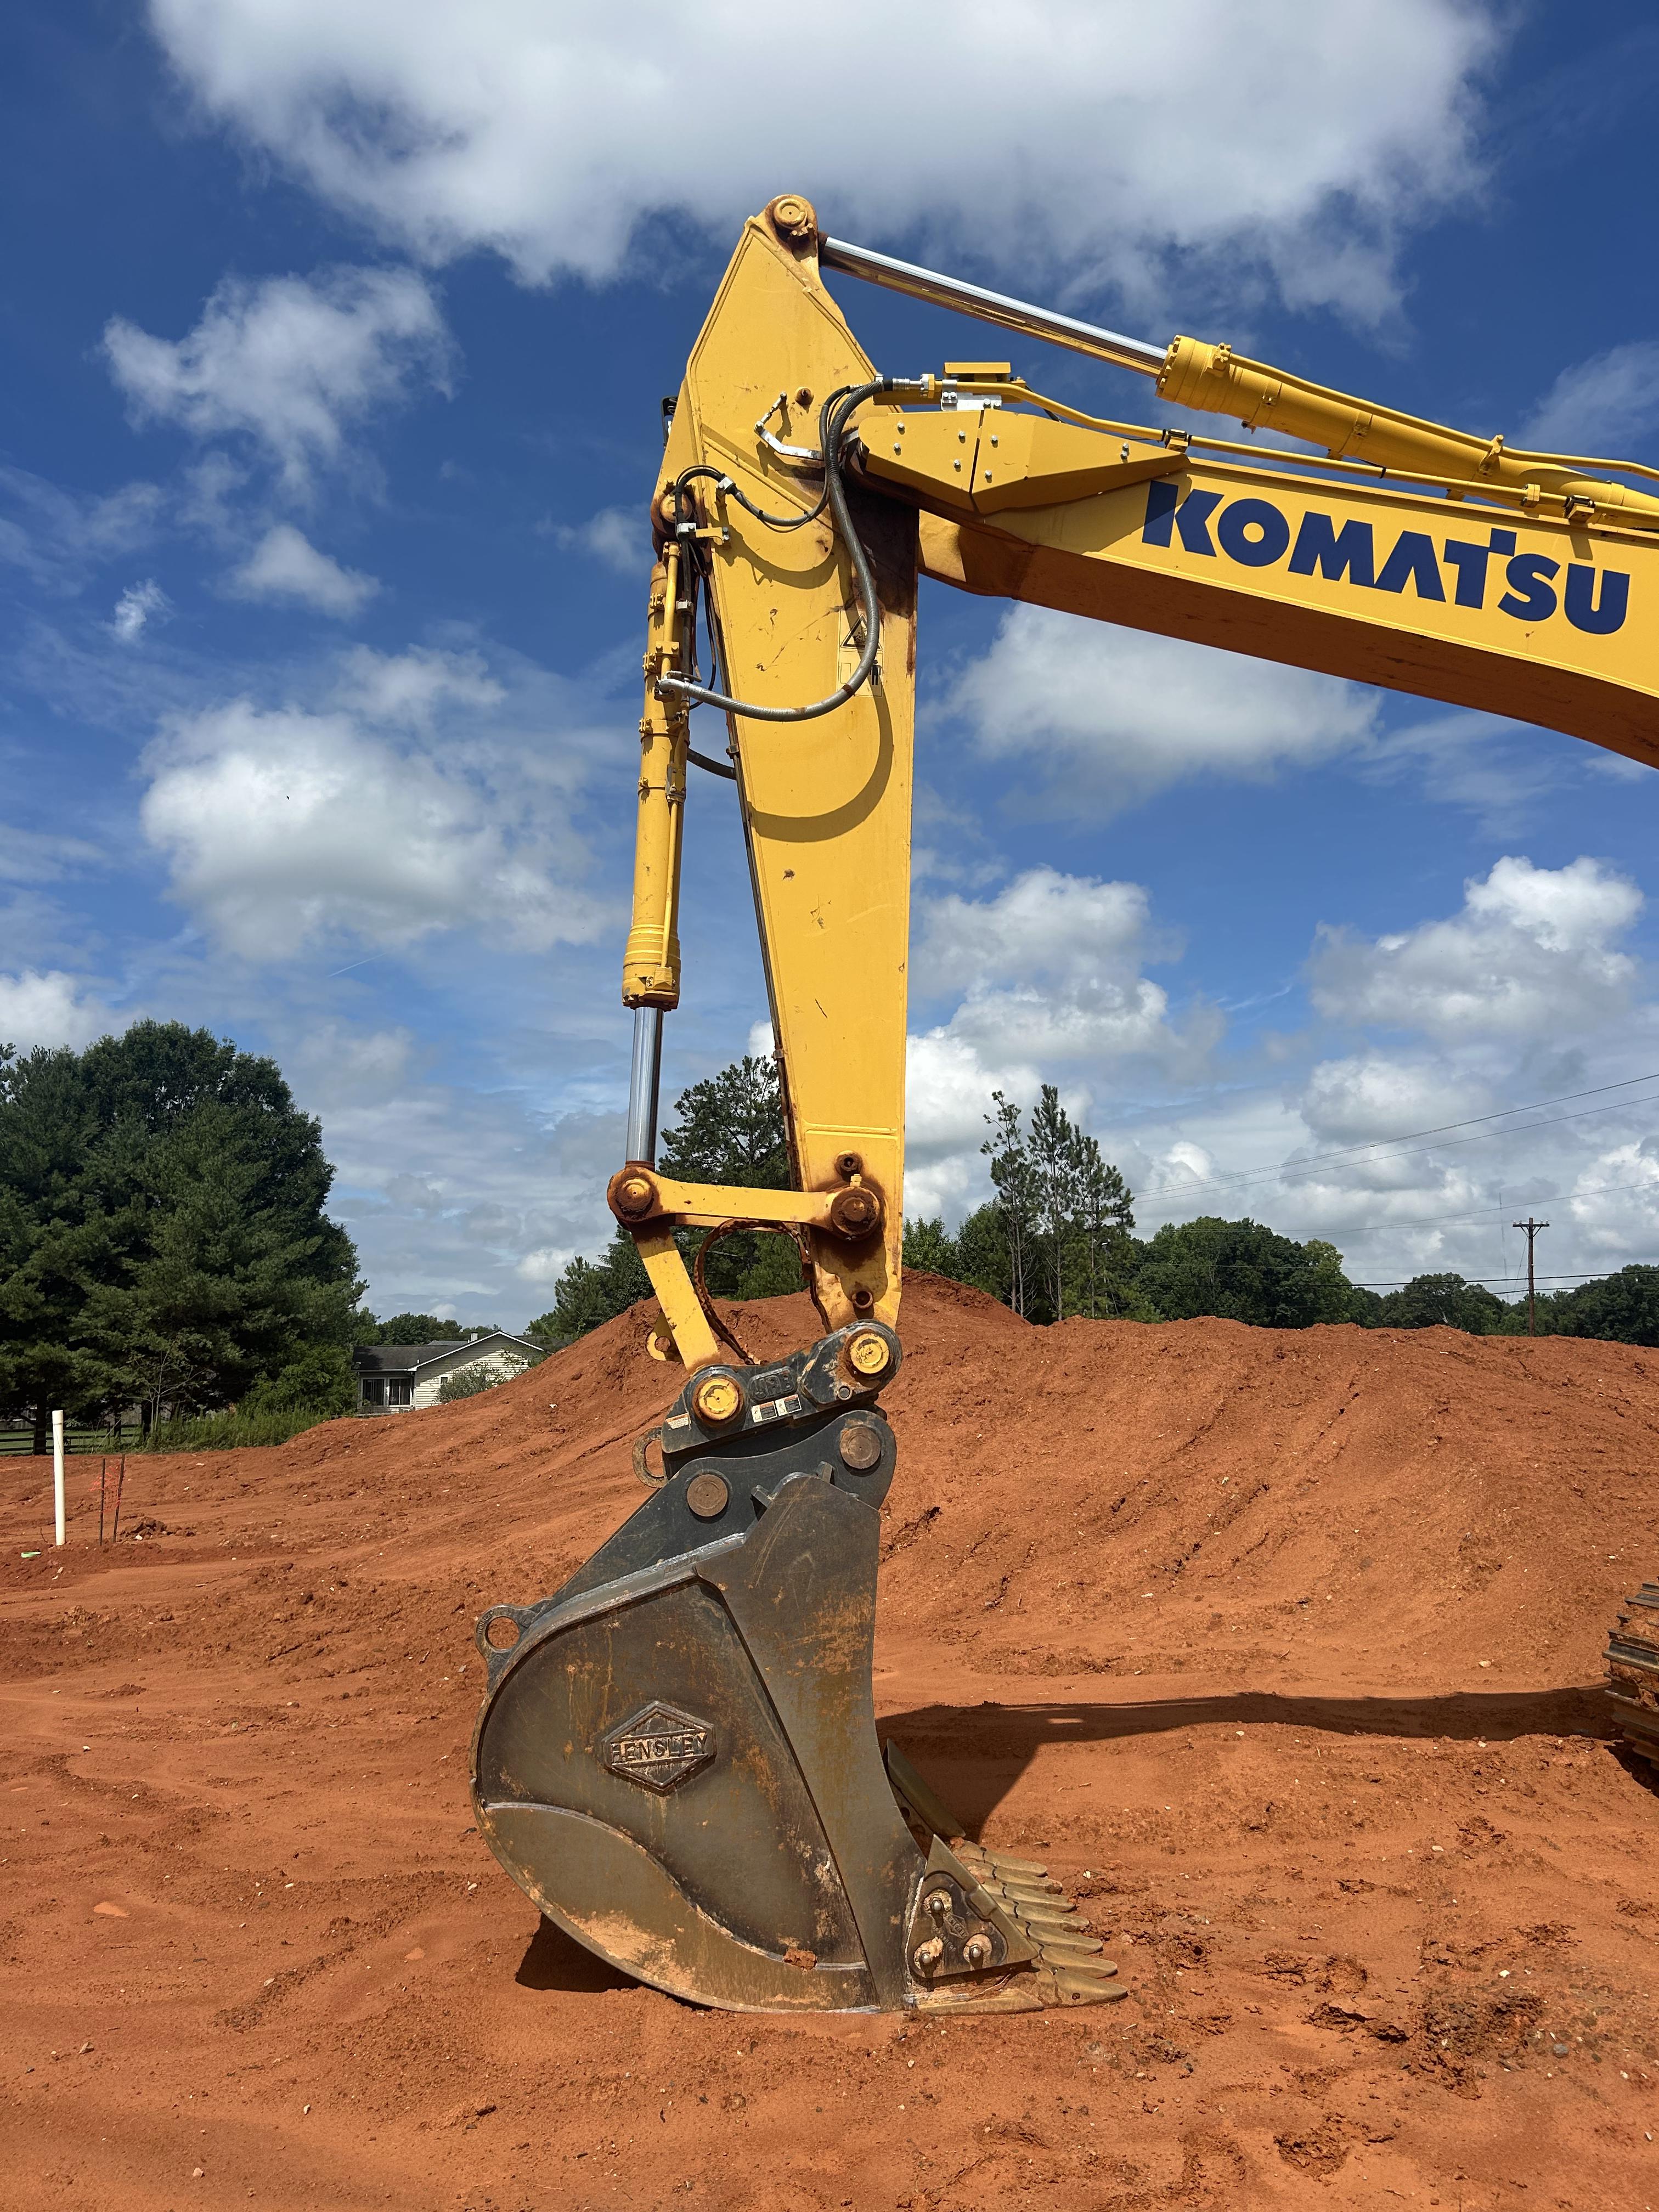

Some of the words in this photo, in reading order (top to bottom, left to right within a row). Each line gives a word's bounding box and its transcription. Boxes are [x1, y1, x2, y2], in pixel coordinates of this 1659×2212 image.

[1143, 480, 1630, 634] KOMATSU
[754, 1369, 794, 1399] JRB
[611, 1734, 708, 1764] HENSLEY
